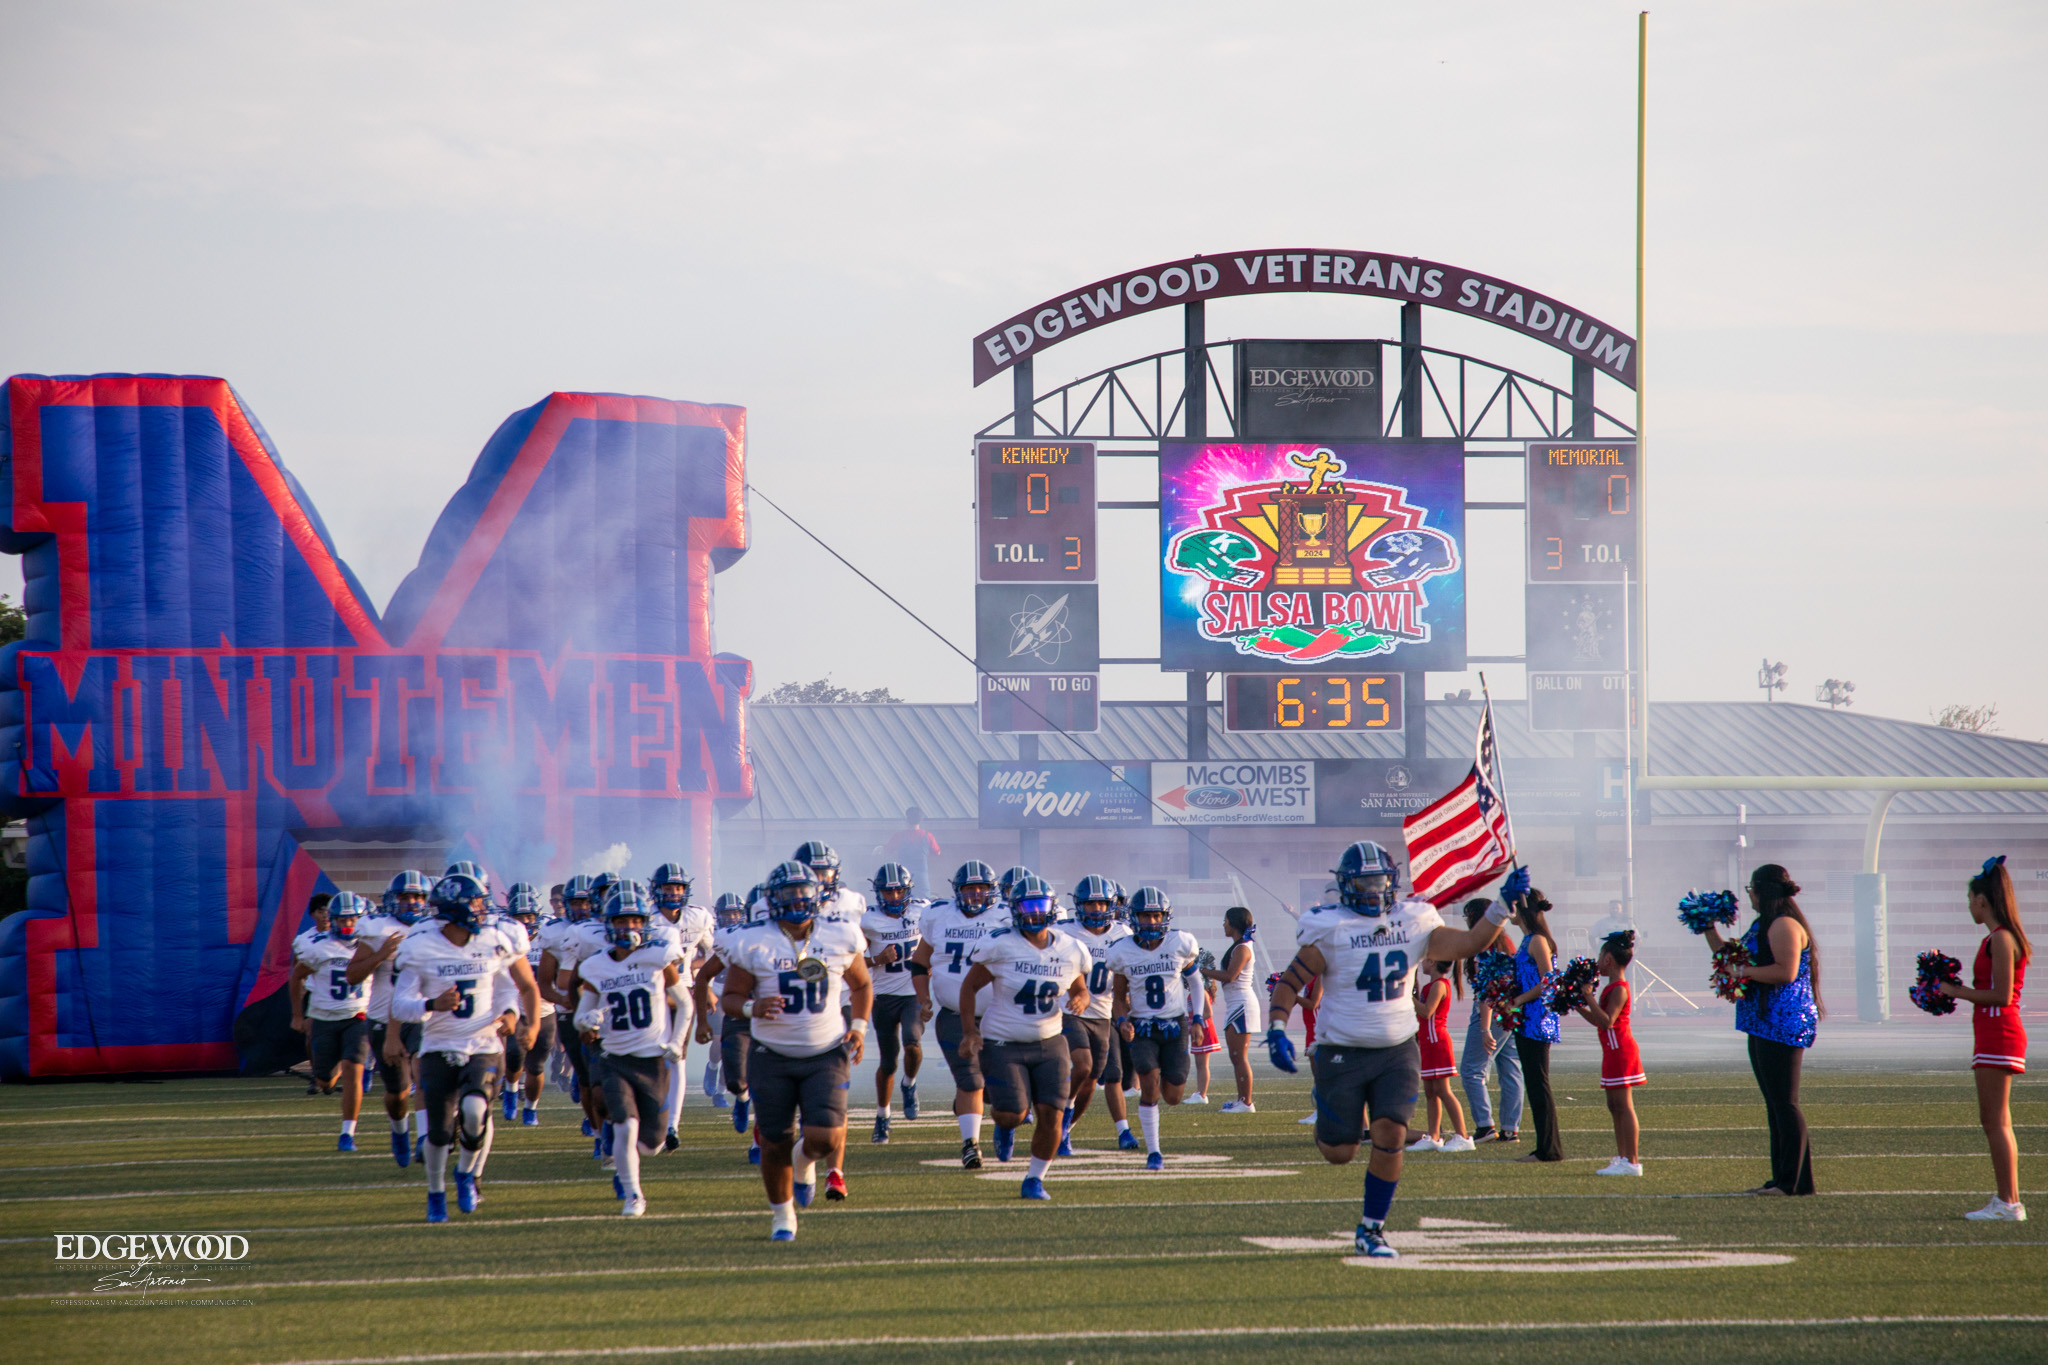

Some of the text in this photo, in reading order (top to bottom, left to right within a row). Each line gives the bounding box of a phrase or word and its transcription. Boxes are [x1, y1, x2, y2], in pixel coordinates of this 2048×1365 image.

[983, 254, 1632, 372] EDGEWOOD VETERANS STADIUM
[1249, 369, 1375, 387] EDGEWOOD
[1002, 447, 1070, 464] KENNEDY
[1548, 449, 1625, 466] MEMORIAL
[1026, 473, 1050, 514] 0
[1607, 474, 1630, 515] 0
[1209, 533, 1241, 552] K
[994, 543, 1045, 563] T.O.L.
[1064, 536, 1081, 570] 3
[1304, 549, 1323, 558] 2024
[1546, 537, 1562, 571] 3
[1205, 592, 1423, 636] SALSA BOWL
[987, 677, 1091, 692] DOWN TO GO
[1536, 676, 1564, 690] BALL
[1566, 676, 1582, 690] ON
[1277, 678, 1389, 727] 6:35
[20, 652, 750, 795] MINUTEMEN
[987, 770, 1051, 790] MADE
[1186, 765, 1307, 786] McCOMBS
[998, 790, 1091, 817] FOR YOU!
[1197, 788, 1230, 805] Ford
[1245, 787, 1310, 807] WEST
[1361, 798, 1383, 808] SAN
[1163, 813, 1305, 823] www.McCombsFordWest.com
[1595, 809, 1619, 819] Open
[1349, 931, 1410, 949] MEMORIAL
[1014, 961, 1064, 977] MEMORIAL
[1130, 961, 1176, 977] MEMORIAL
[1355, 949, 1409, 1003] 42
[600, 973, 649, 991] MEMORIAL
[778, 970, 829, 1014] 50
[453, 979, 477, 1018] 5
[1145, 975, 1166, 1010] 8
[606, 987, 653, 1031] 20
